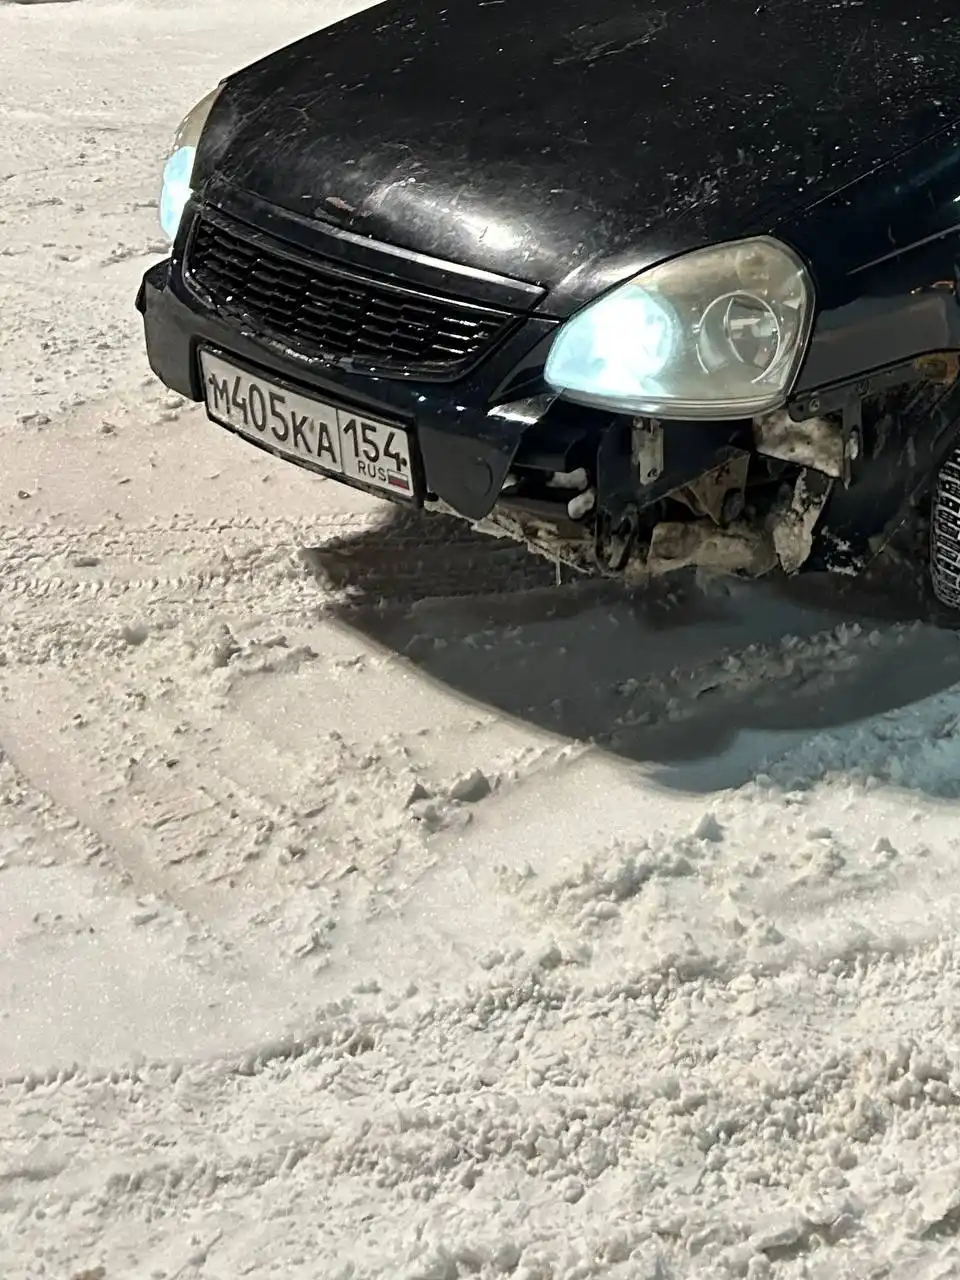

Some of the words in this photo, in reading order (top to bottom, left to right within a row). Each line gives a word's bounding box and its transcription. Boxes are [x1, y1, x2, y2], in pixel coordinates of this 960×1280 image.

[210, 372, 338, 464] М405КА
[343, 417, 402, 472] 154
[357, 459, 387, 482] RUS
